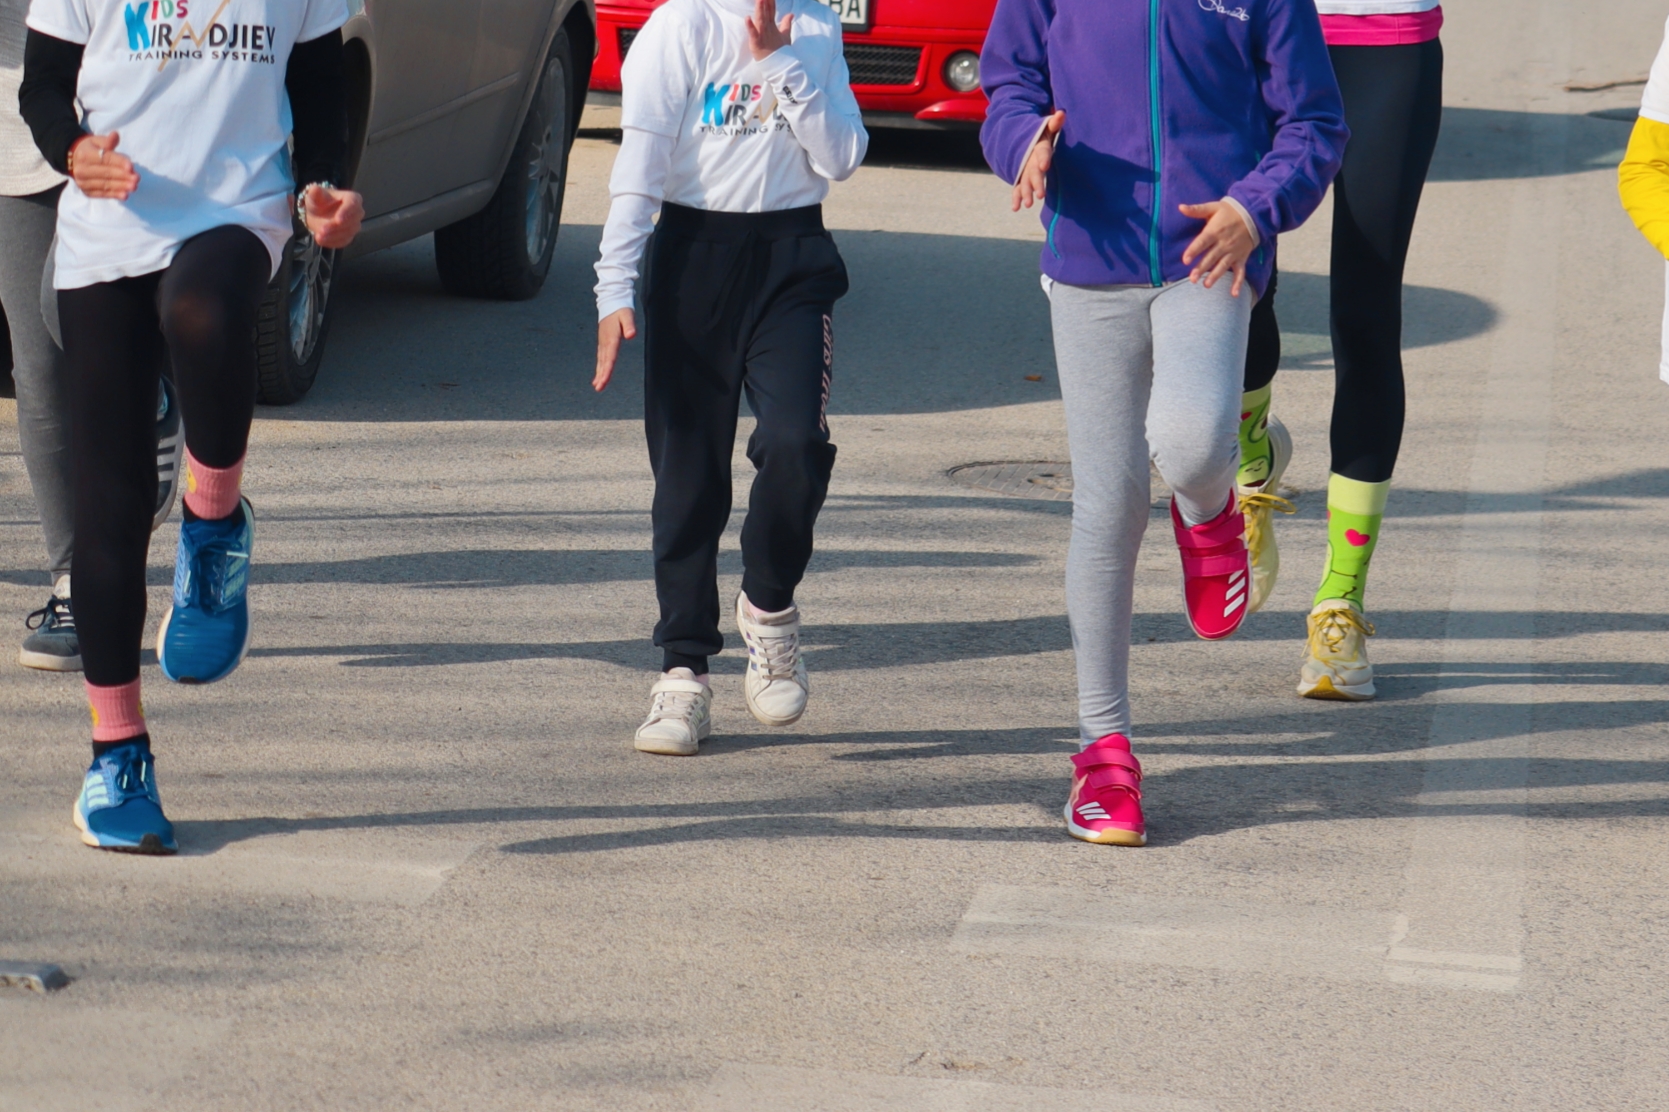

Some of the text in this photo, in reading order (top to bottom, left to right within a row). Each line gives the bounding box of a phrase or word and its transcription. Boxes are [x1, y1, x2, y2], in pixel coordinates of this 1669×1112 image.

[129, 50, 275, 64] TRAINING SYSTEMS
[700, 126, 768, 136] TRAINING
